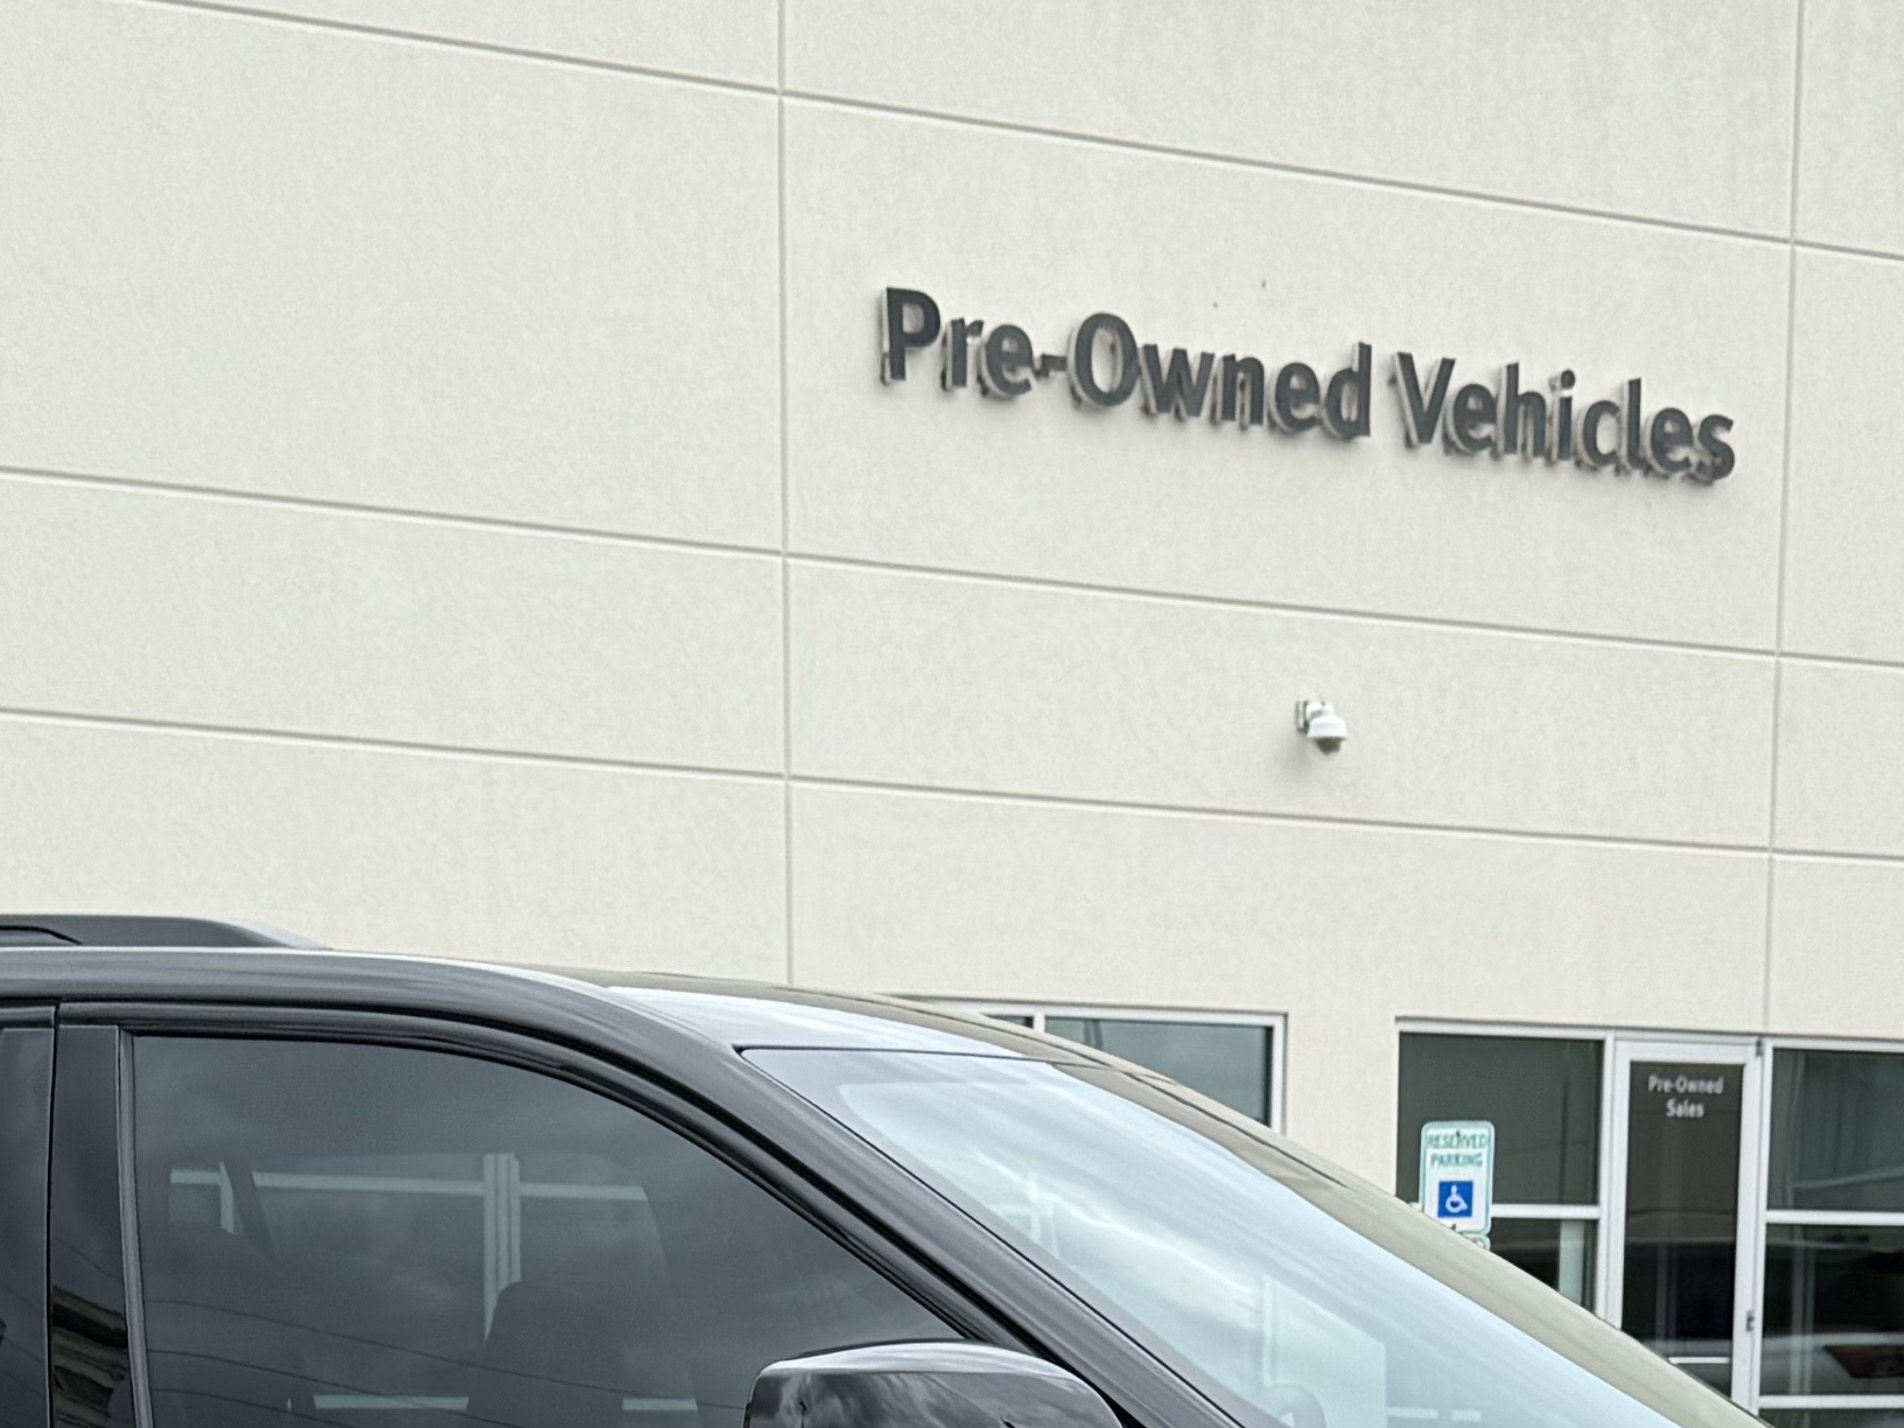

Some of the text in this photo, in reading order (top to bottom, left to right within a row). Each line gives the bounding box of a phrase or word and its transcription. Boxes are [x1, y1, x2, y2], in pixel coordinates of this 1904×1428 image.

[881, 285, 1736, 484] Pre-Owned Vehicles
[1647, 1073, 1725, 1095] Pre-Owned
[1664, 1098, 1705, 1118] Sales
[1427, 1132, 1487, 1149] RESERVED
[1430, 1152, 1483, 1167] PARKING
